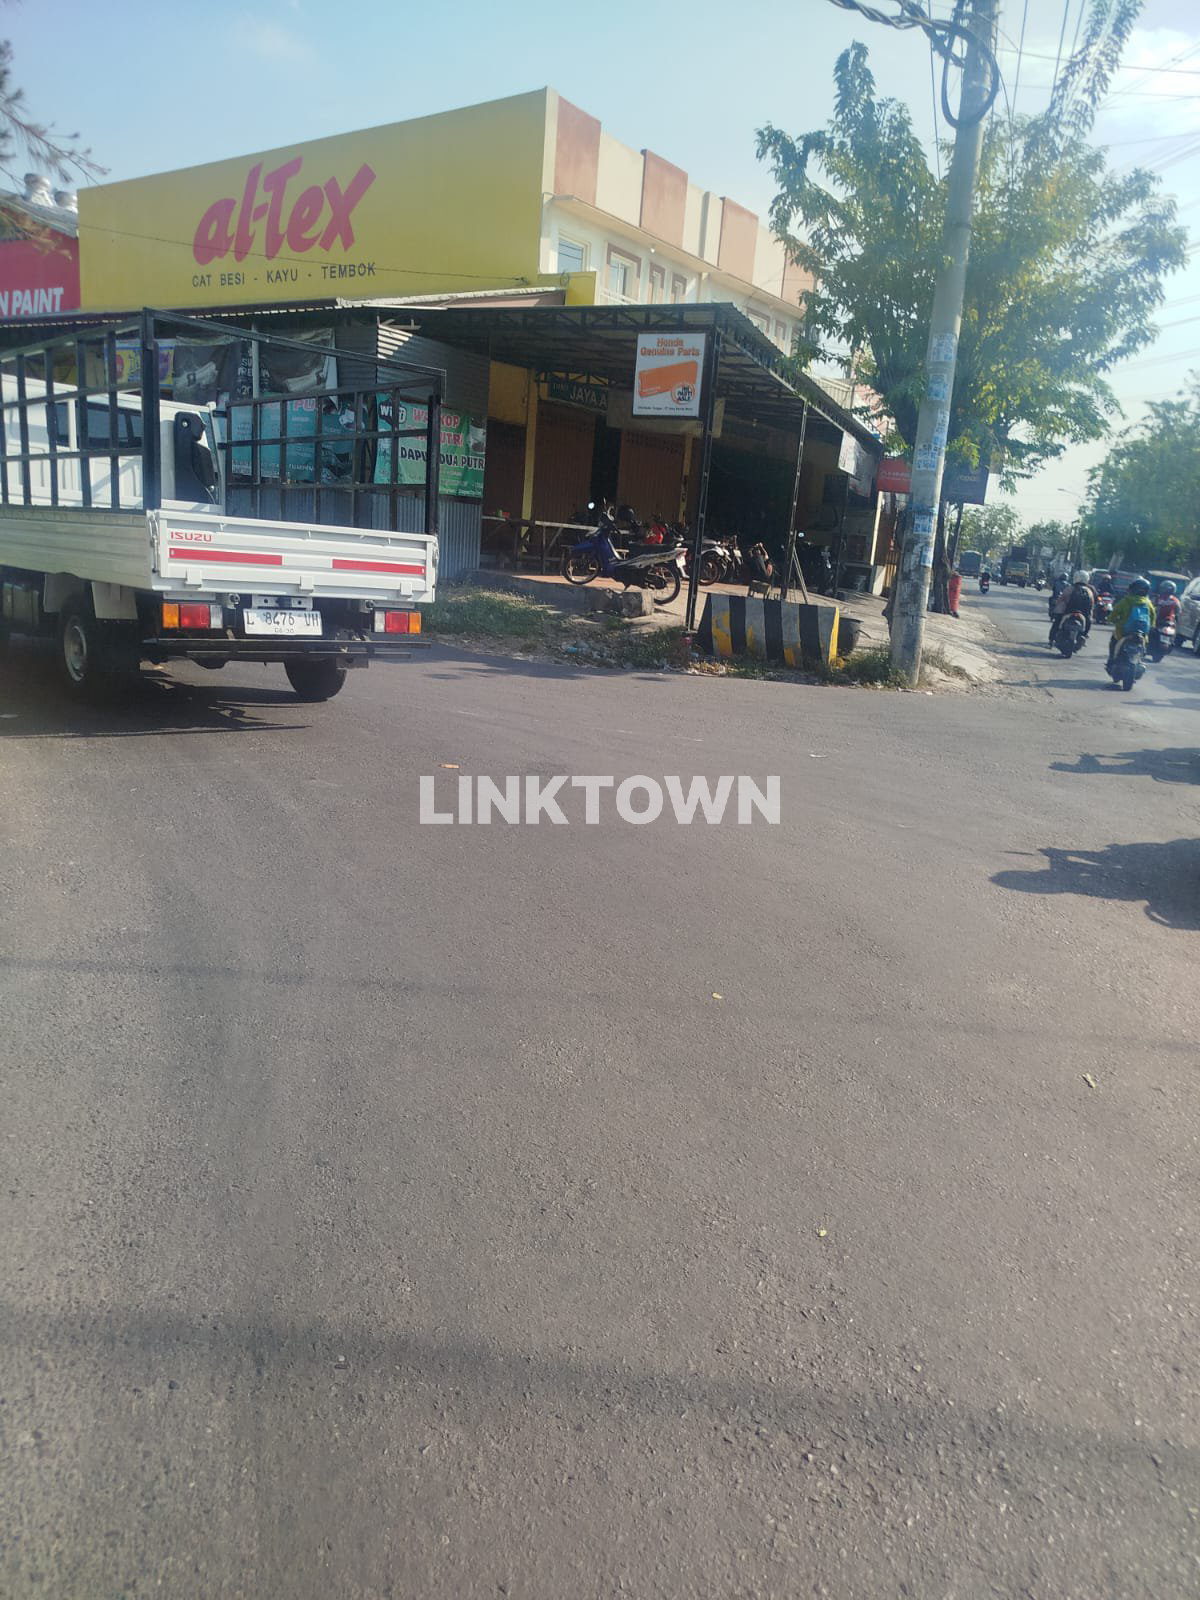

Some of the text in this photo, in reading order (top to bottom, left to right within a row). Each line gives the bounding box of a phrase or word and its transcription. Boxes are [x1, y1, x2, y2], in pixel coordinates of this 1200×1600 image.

[193, 156, 376, 266] al-Tex
[192, 274, 212, 288] CAT
[220, 272, 245, 286] BESI
[266, 269, 298, 284] KAYU
[321, 262, 376, 280] TEMBOK
[12, 287, 64, 315] PAINT
[171, 531, 212, 542] ISUZU
[246, 610, 255, 625] L
